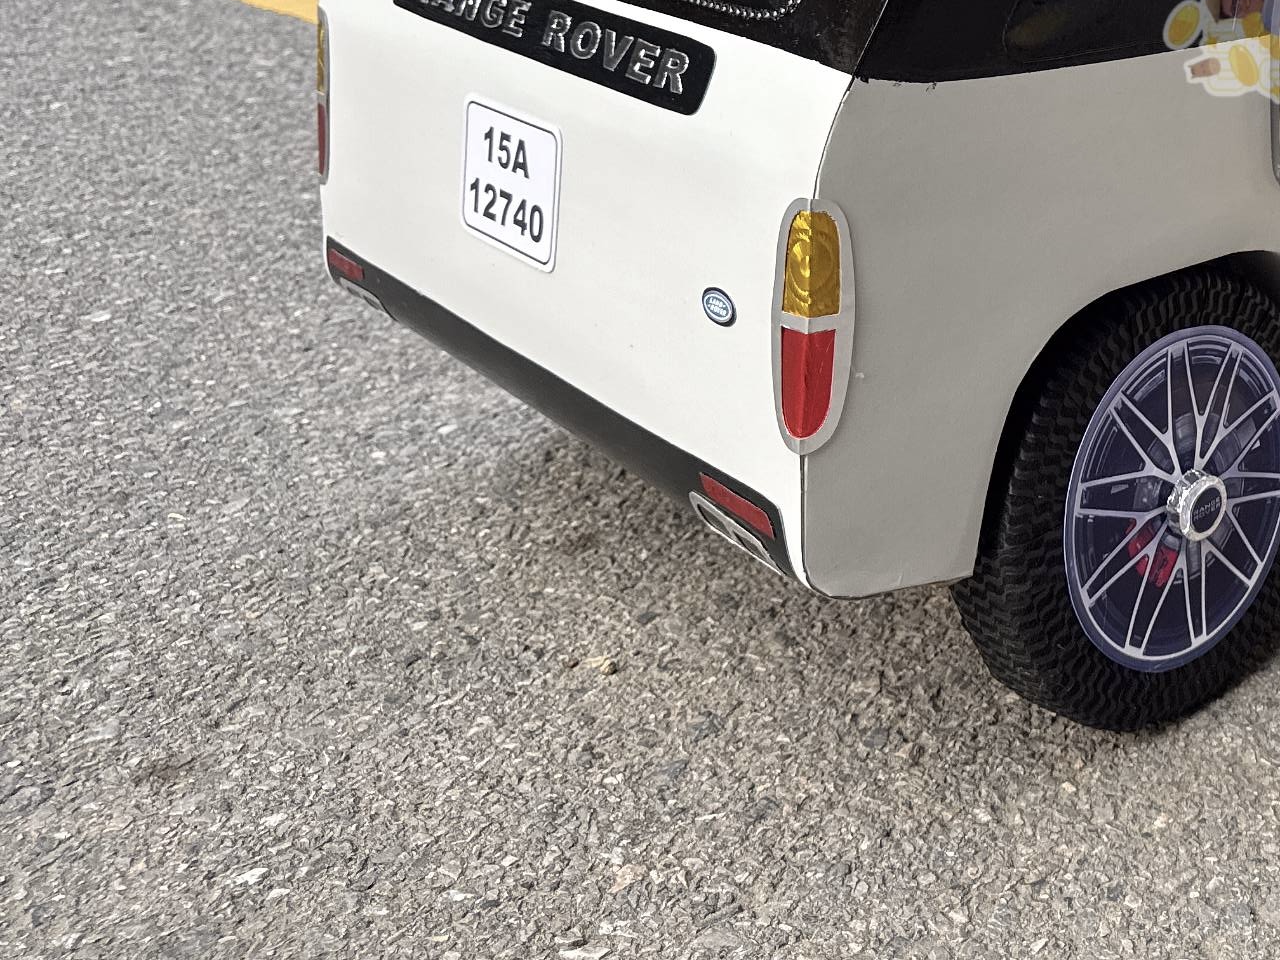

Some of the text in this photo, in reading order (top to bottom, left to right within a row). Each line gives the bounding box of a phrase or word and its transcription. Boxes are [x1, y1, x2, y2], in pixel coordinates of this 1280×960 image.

[540, 9, 691, 95] ROVER
[469, 125, 545, 244] 15A 12740
